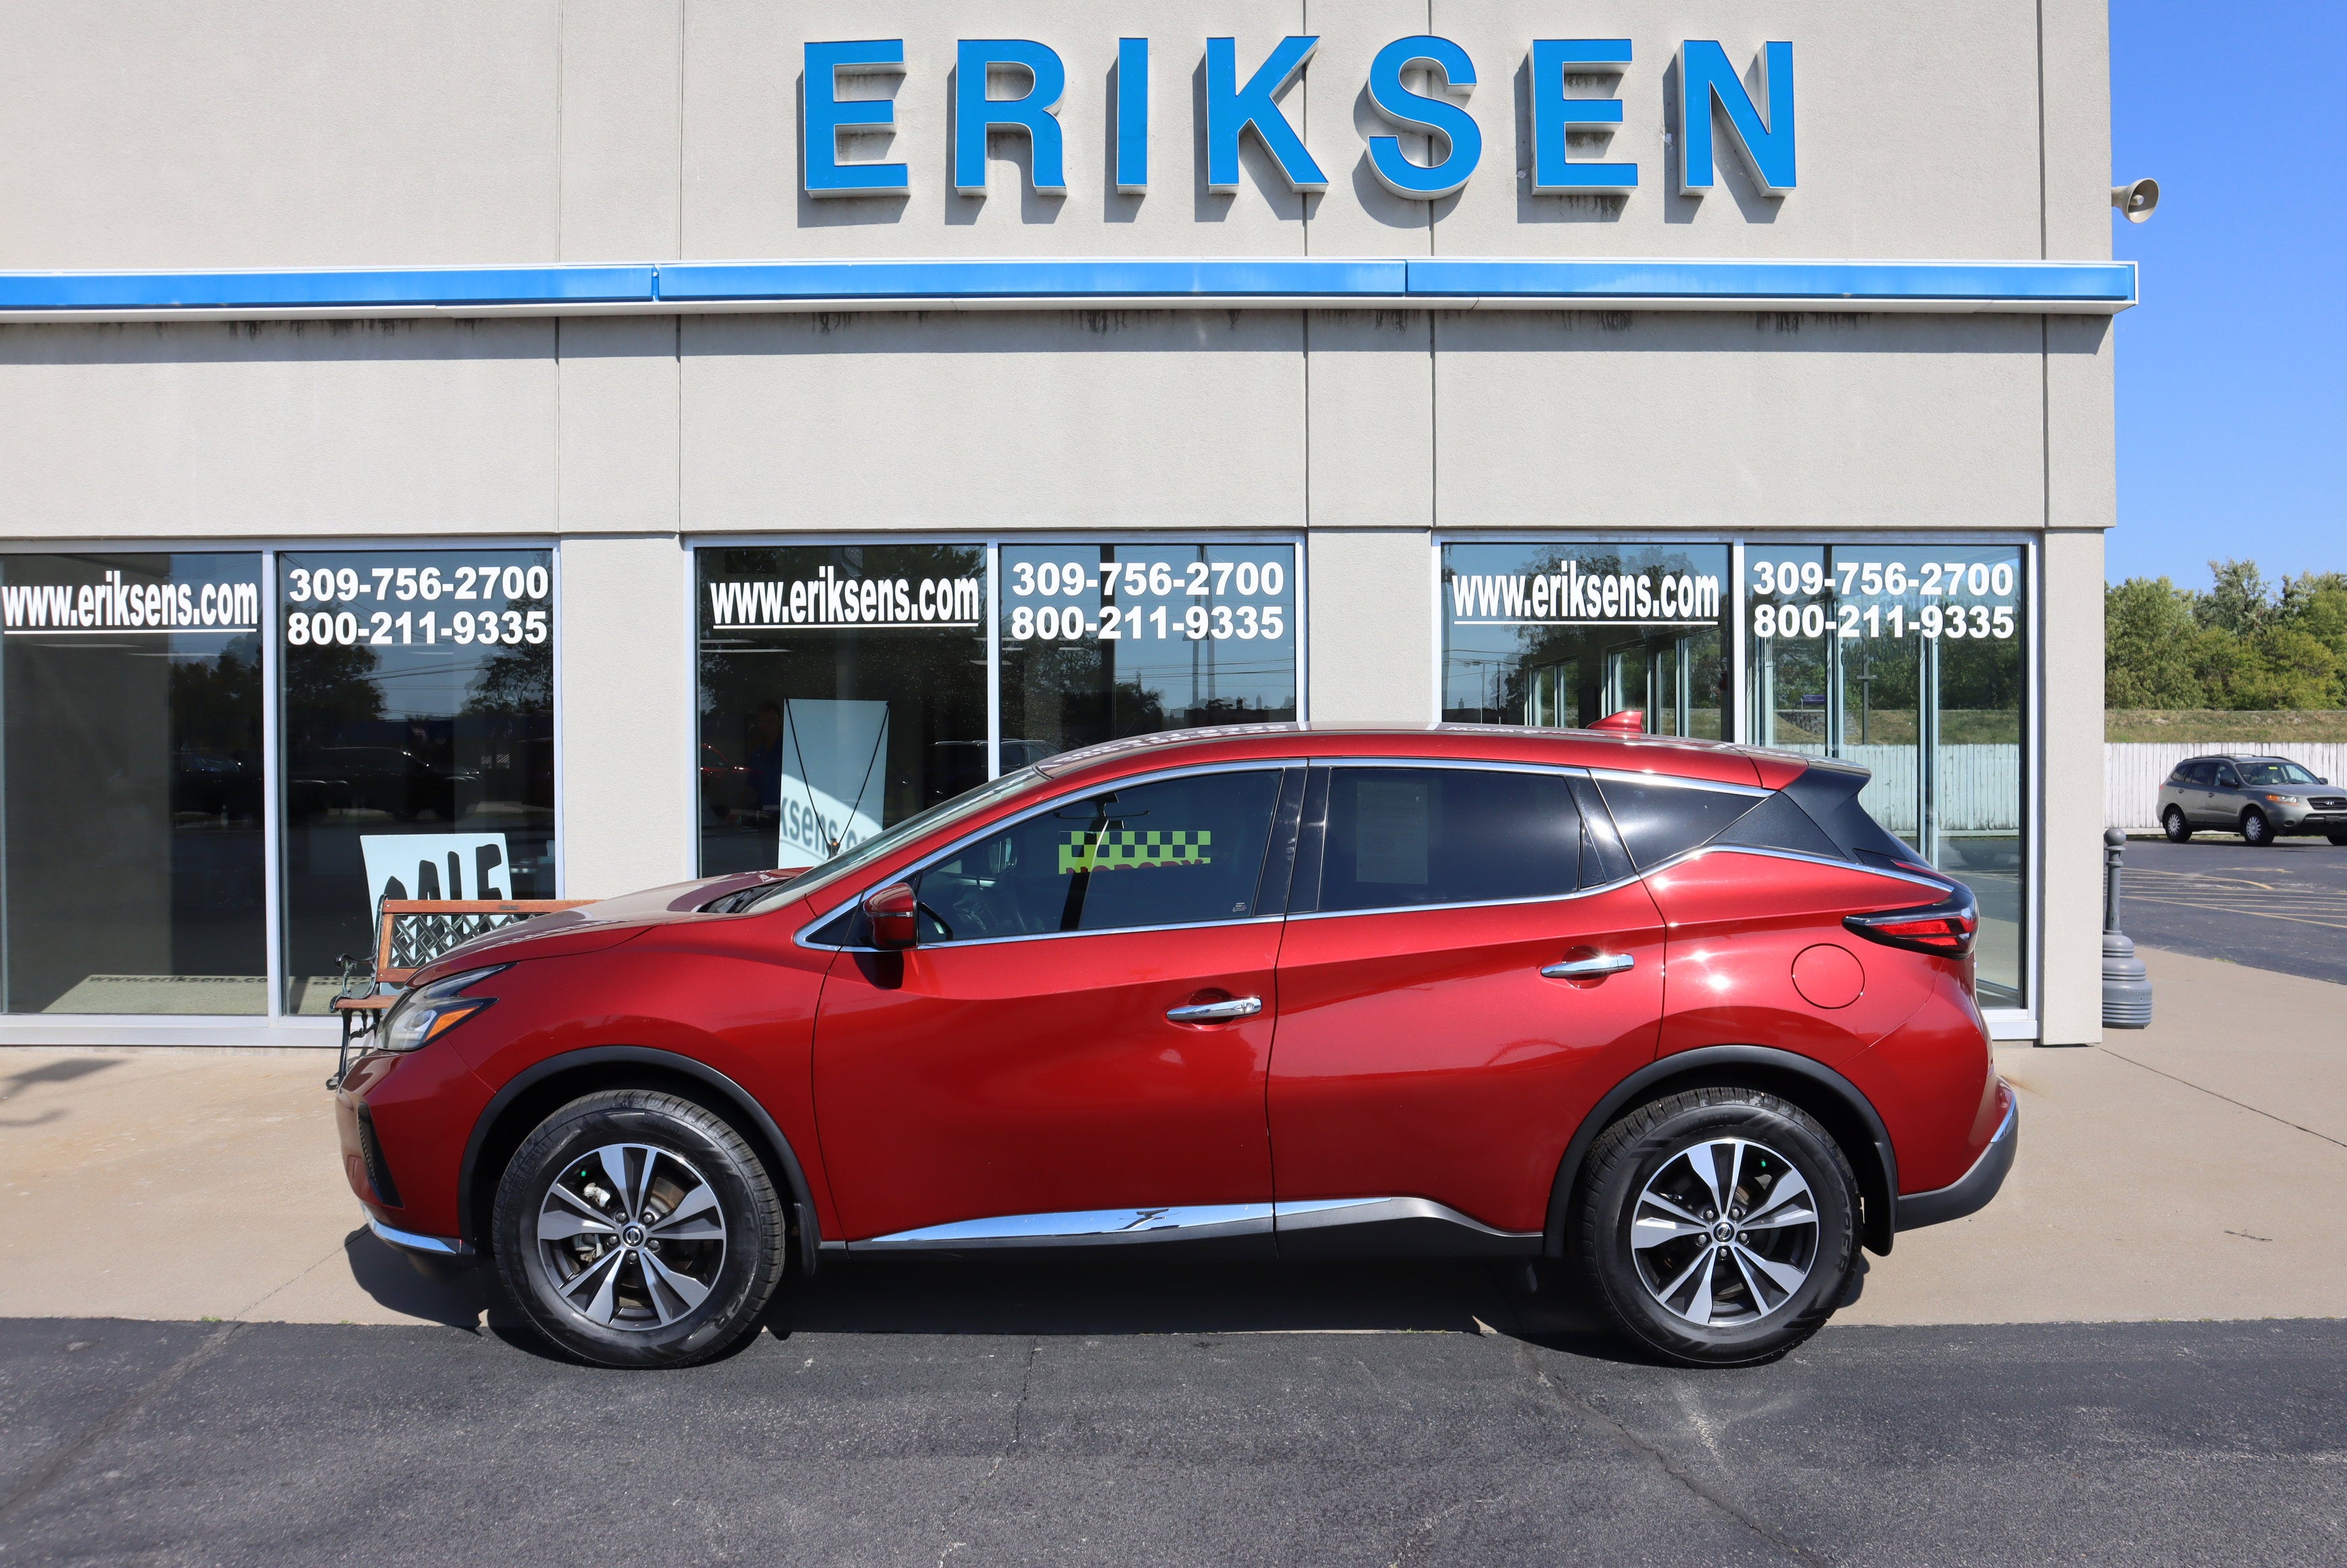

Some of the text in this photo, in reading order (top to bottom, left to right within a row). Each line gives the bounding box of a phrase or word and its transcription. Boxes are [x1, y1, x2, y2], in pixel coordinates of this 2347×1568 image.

[803, 35, 1799, 199] ERIKSEN
[289, 565, 549, 602] 309-756-2700
[710, 565, 979, 623] www.eriksens.com
[1012, 561, 1284, 597] 309-756-2700
[1451, 560, 1720, 618] www.eriksens.com
[1752, 561, 2014, 597] 309-756-2700
[2, 570, 258, 627] www.eriksens.com
[287, 610, 548, 645] 800-211-9335
[1011, 605, 1284, 641] 800-211-9335
[1753, 604, 2014, 639] 800-211-9335
[89, 975, 267, 983] www.eriksens.co
